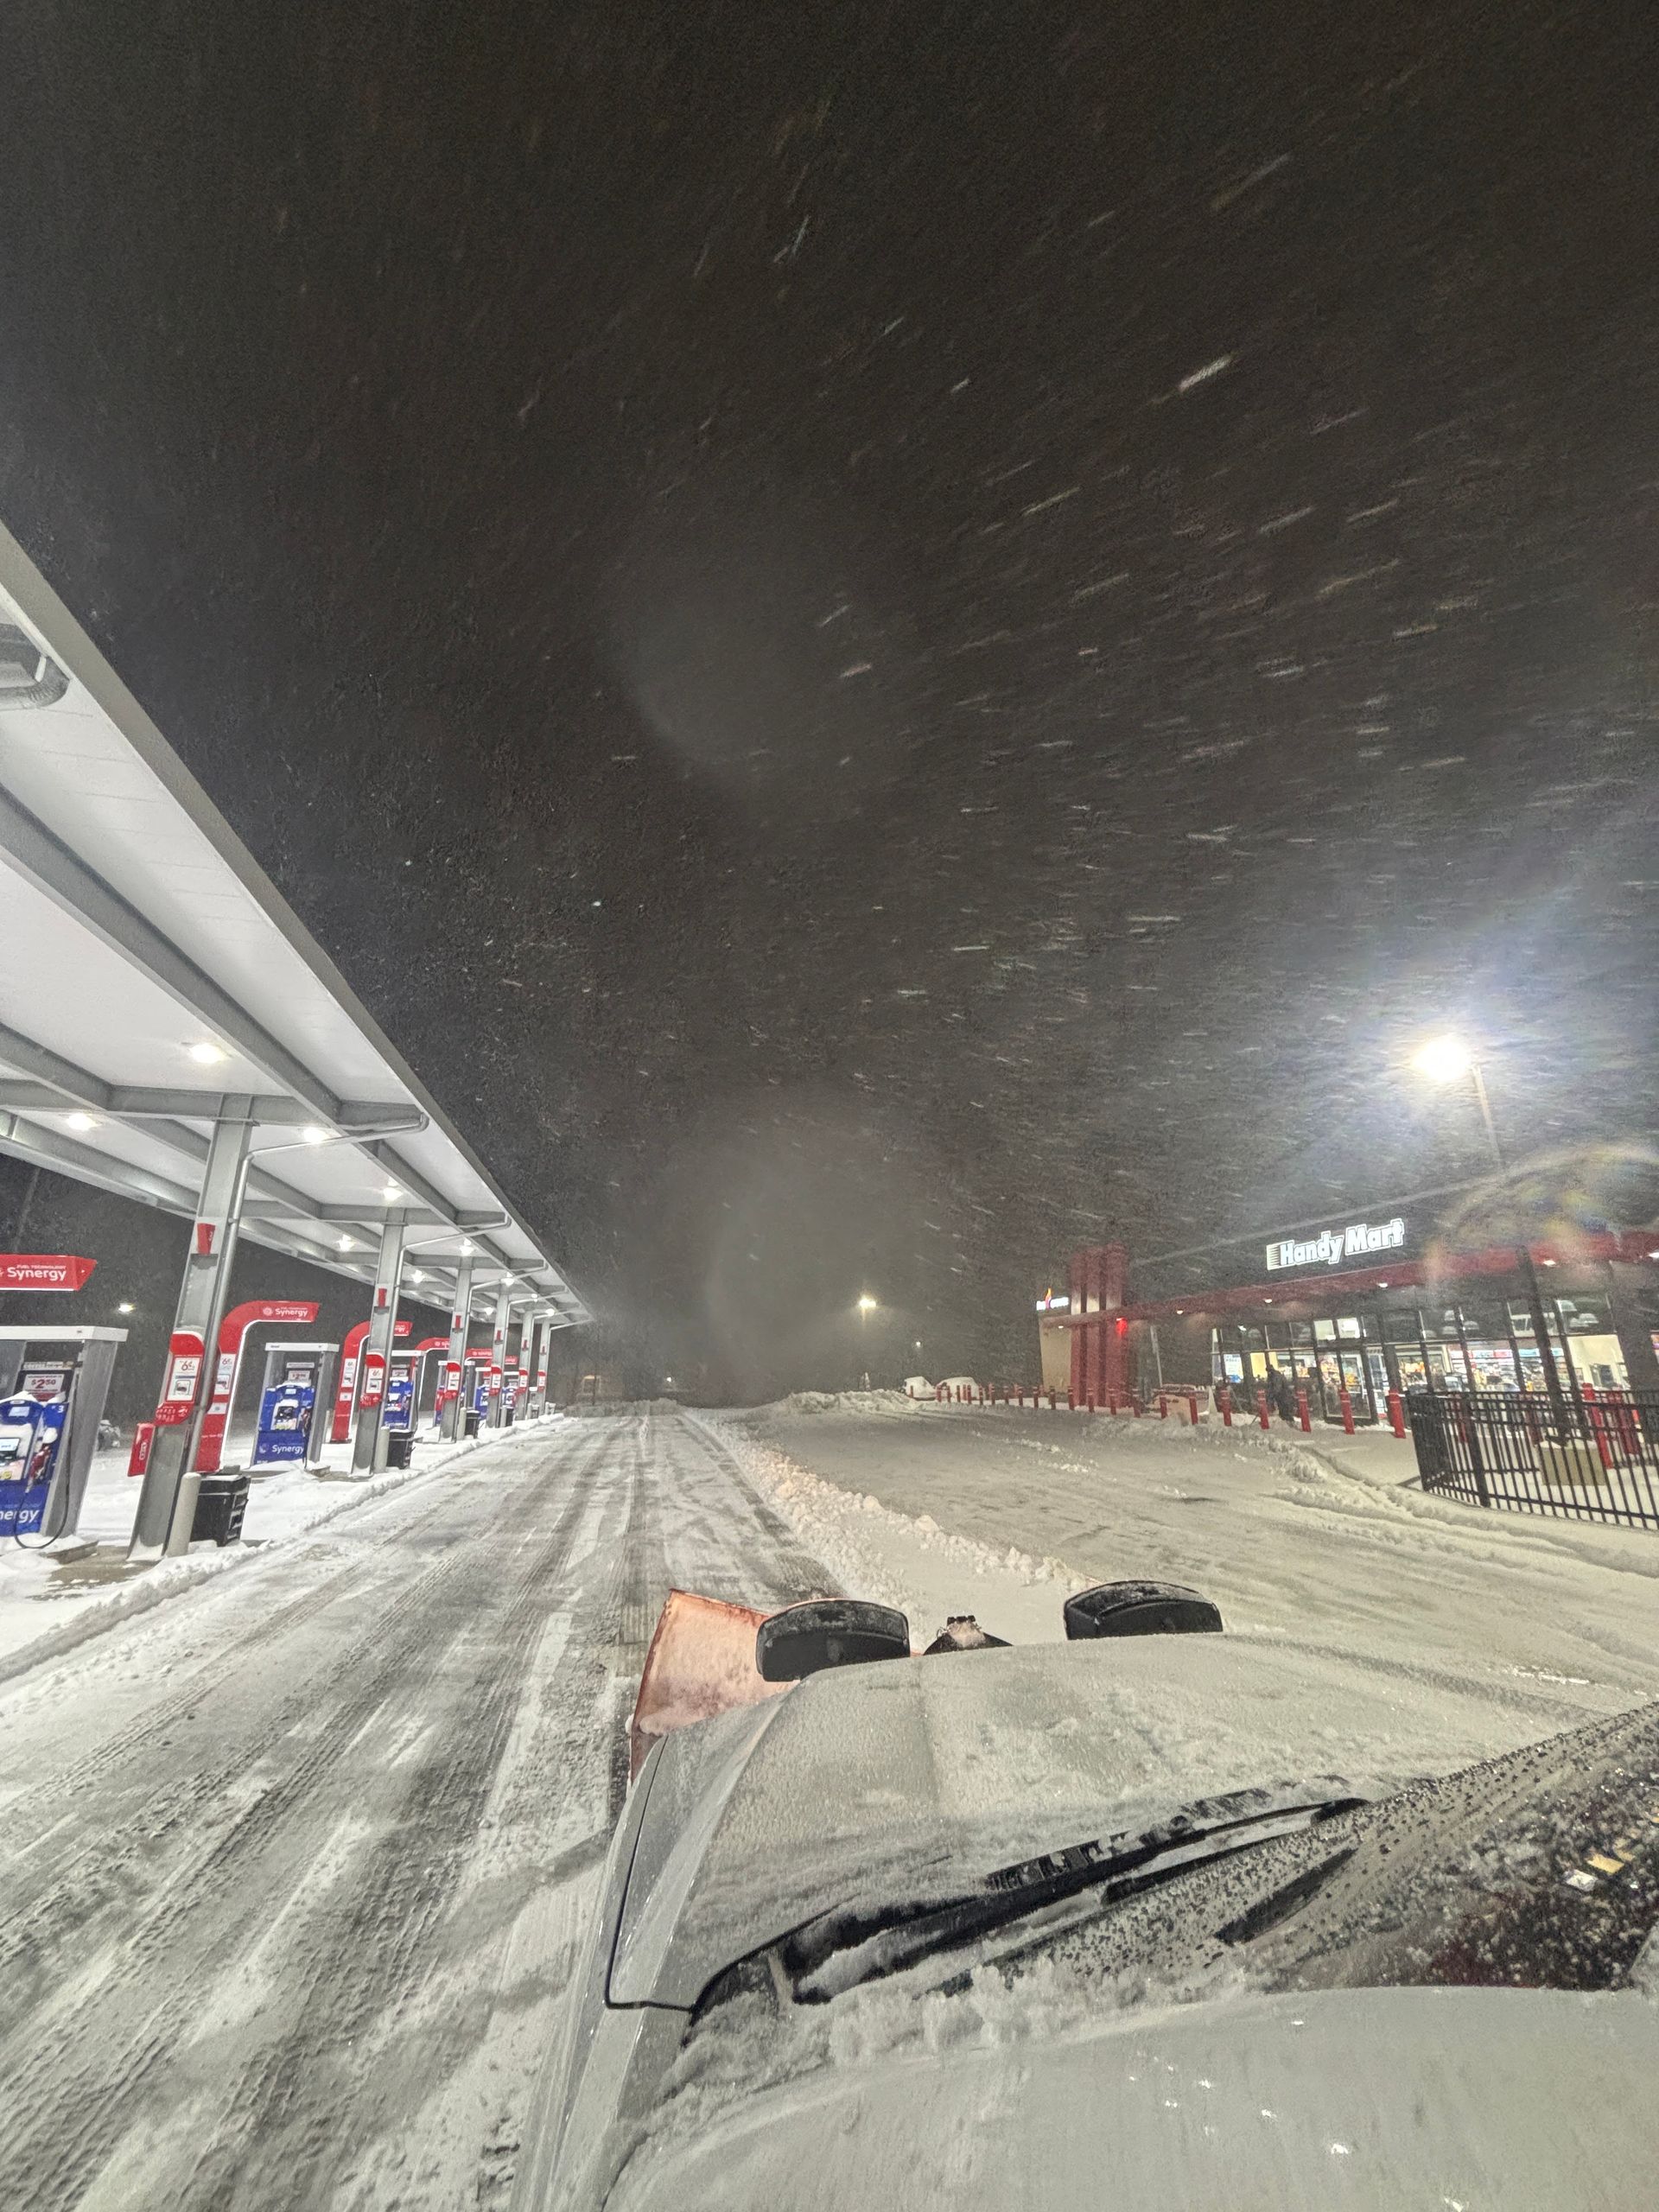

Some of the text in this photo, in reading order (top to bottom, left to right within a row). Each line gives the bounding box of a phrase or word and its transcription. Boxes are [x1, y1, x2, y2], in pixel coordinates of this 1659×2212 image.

[1279, 1218, 1404, 1264] Handy Mart
[7, 1267, 67, 1281] Synergy
[275, 1307, 308, 1317] Synergy
[271, 1444, 304, 1454] Synergy
